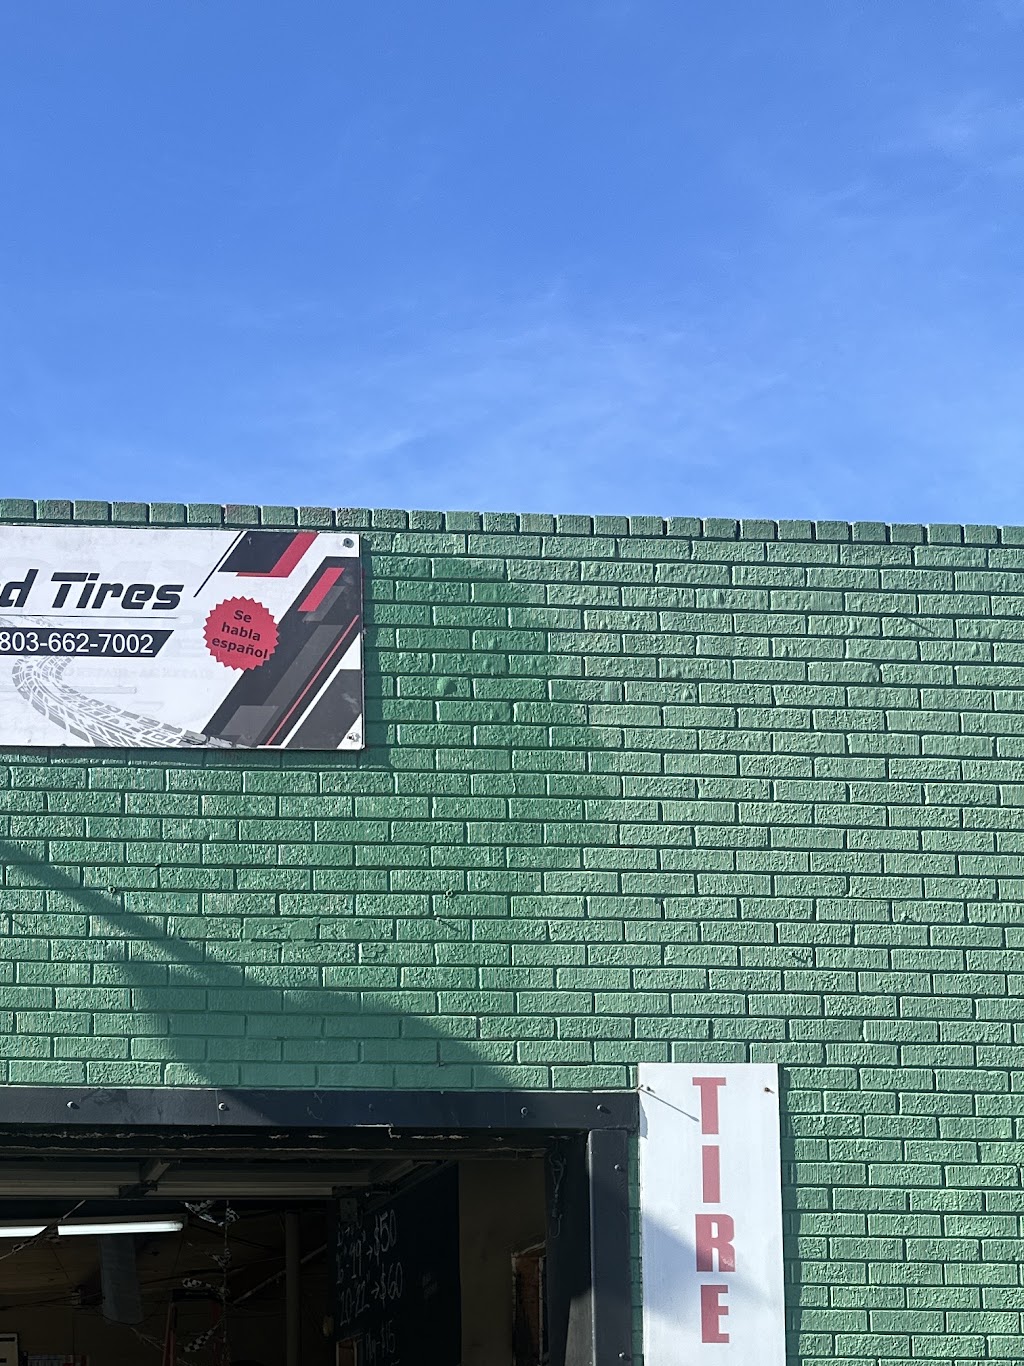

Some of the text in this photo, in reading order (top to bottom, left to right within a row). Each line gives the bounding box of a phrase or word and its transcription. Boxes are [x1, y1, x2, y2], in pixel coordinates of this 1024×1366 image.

[51, 572, 185, 610] Tires
[233, 610, 252, 623] Se
[221, 621, 261, 641] habla
[212, 637, 268, 659] español
[692, 1077, 735, 1343] TIRE
